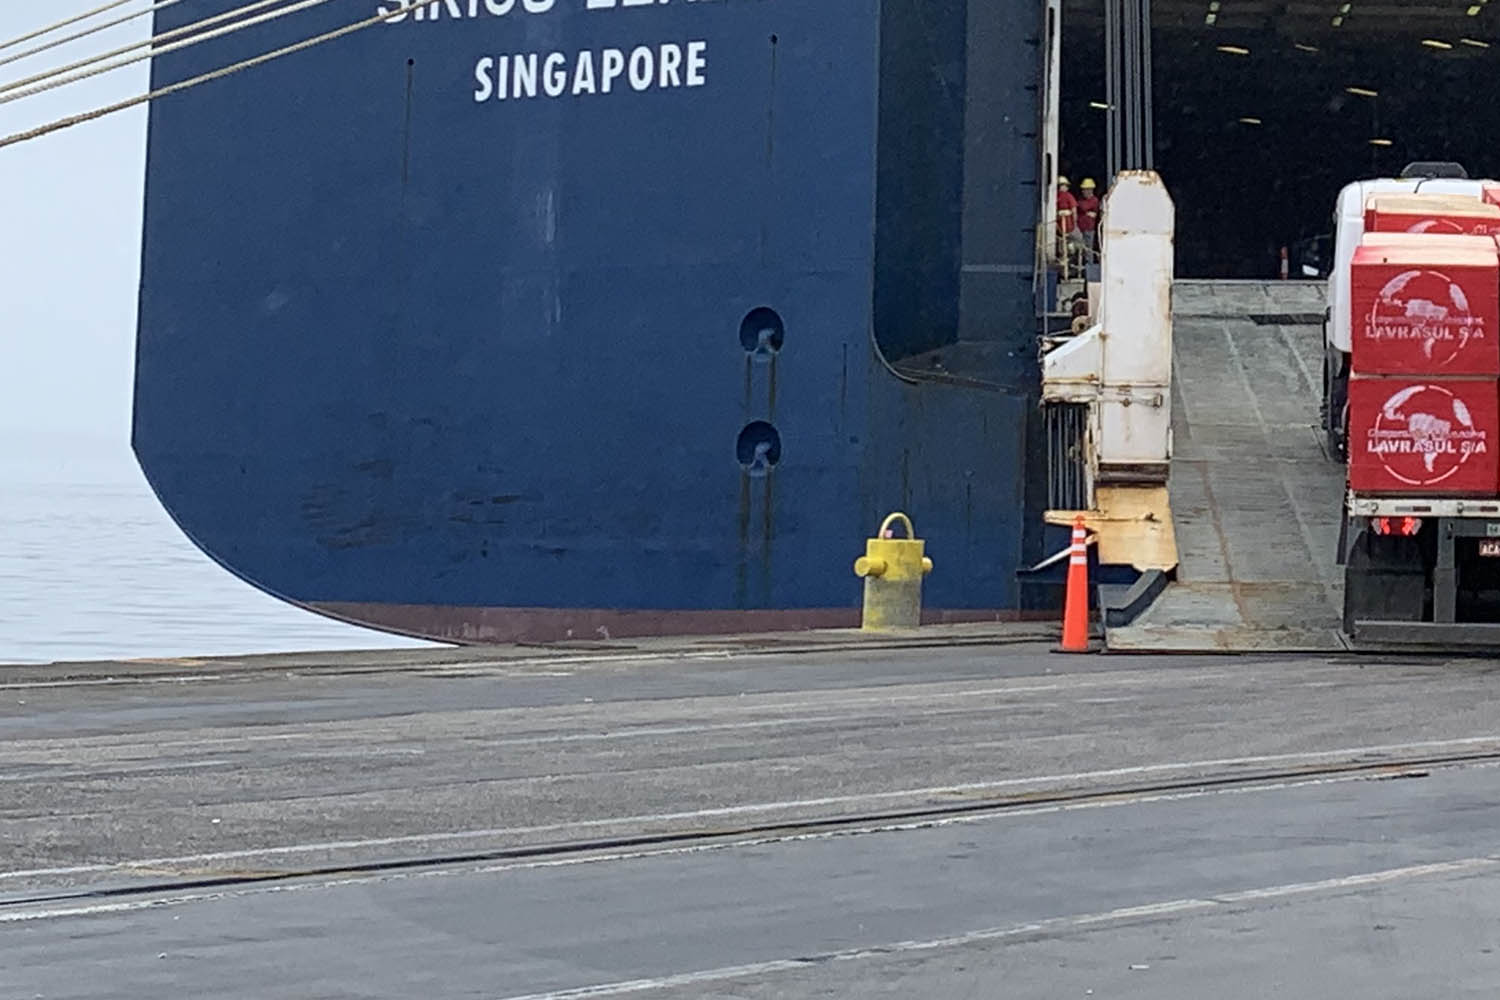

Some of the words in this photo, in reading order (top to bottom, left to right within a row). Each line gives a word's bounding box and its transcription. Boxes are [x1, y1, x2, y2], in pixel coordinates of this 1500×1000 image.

[474, 40, 707, 103] SINGAPORE
[1365, 325, 1454, 340] LAVRASUL
[1367, 439, 1456, 454] LAVRASUL
